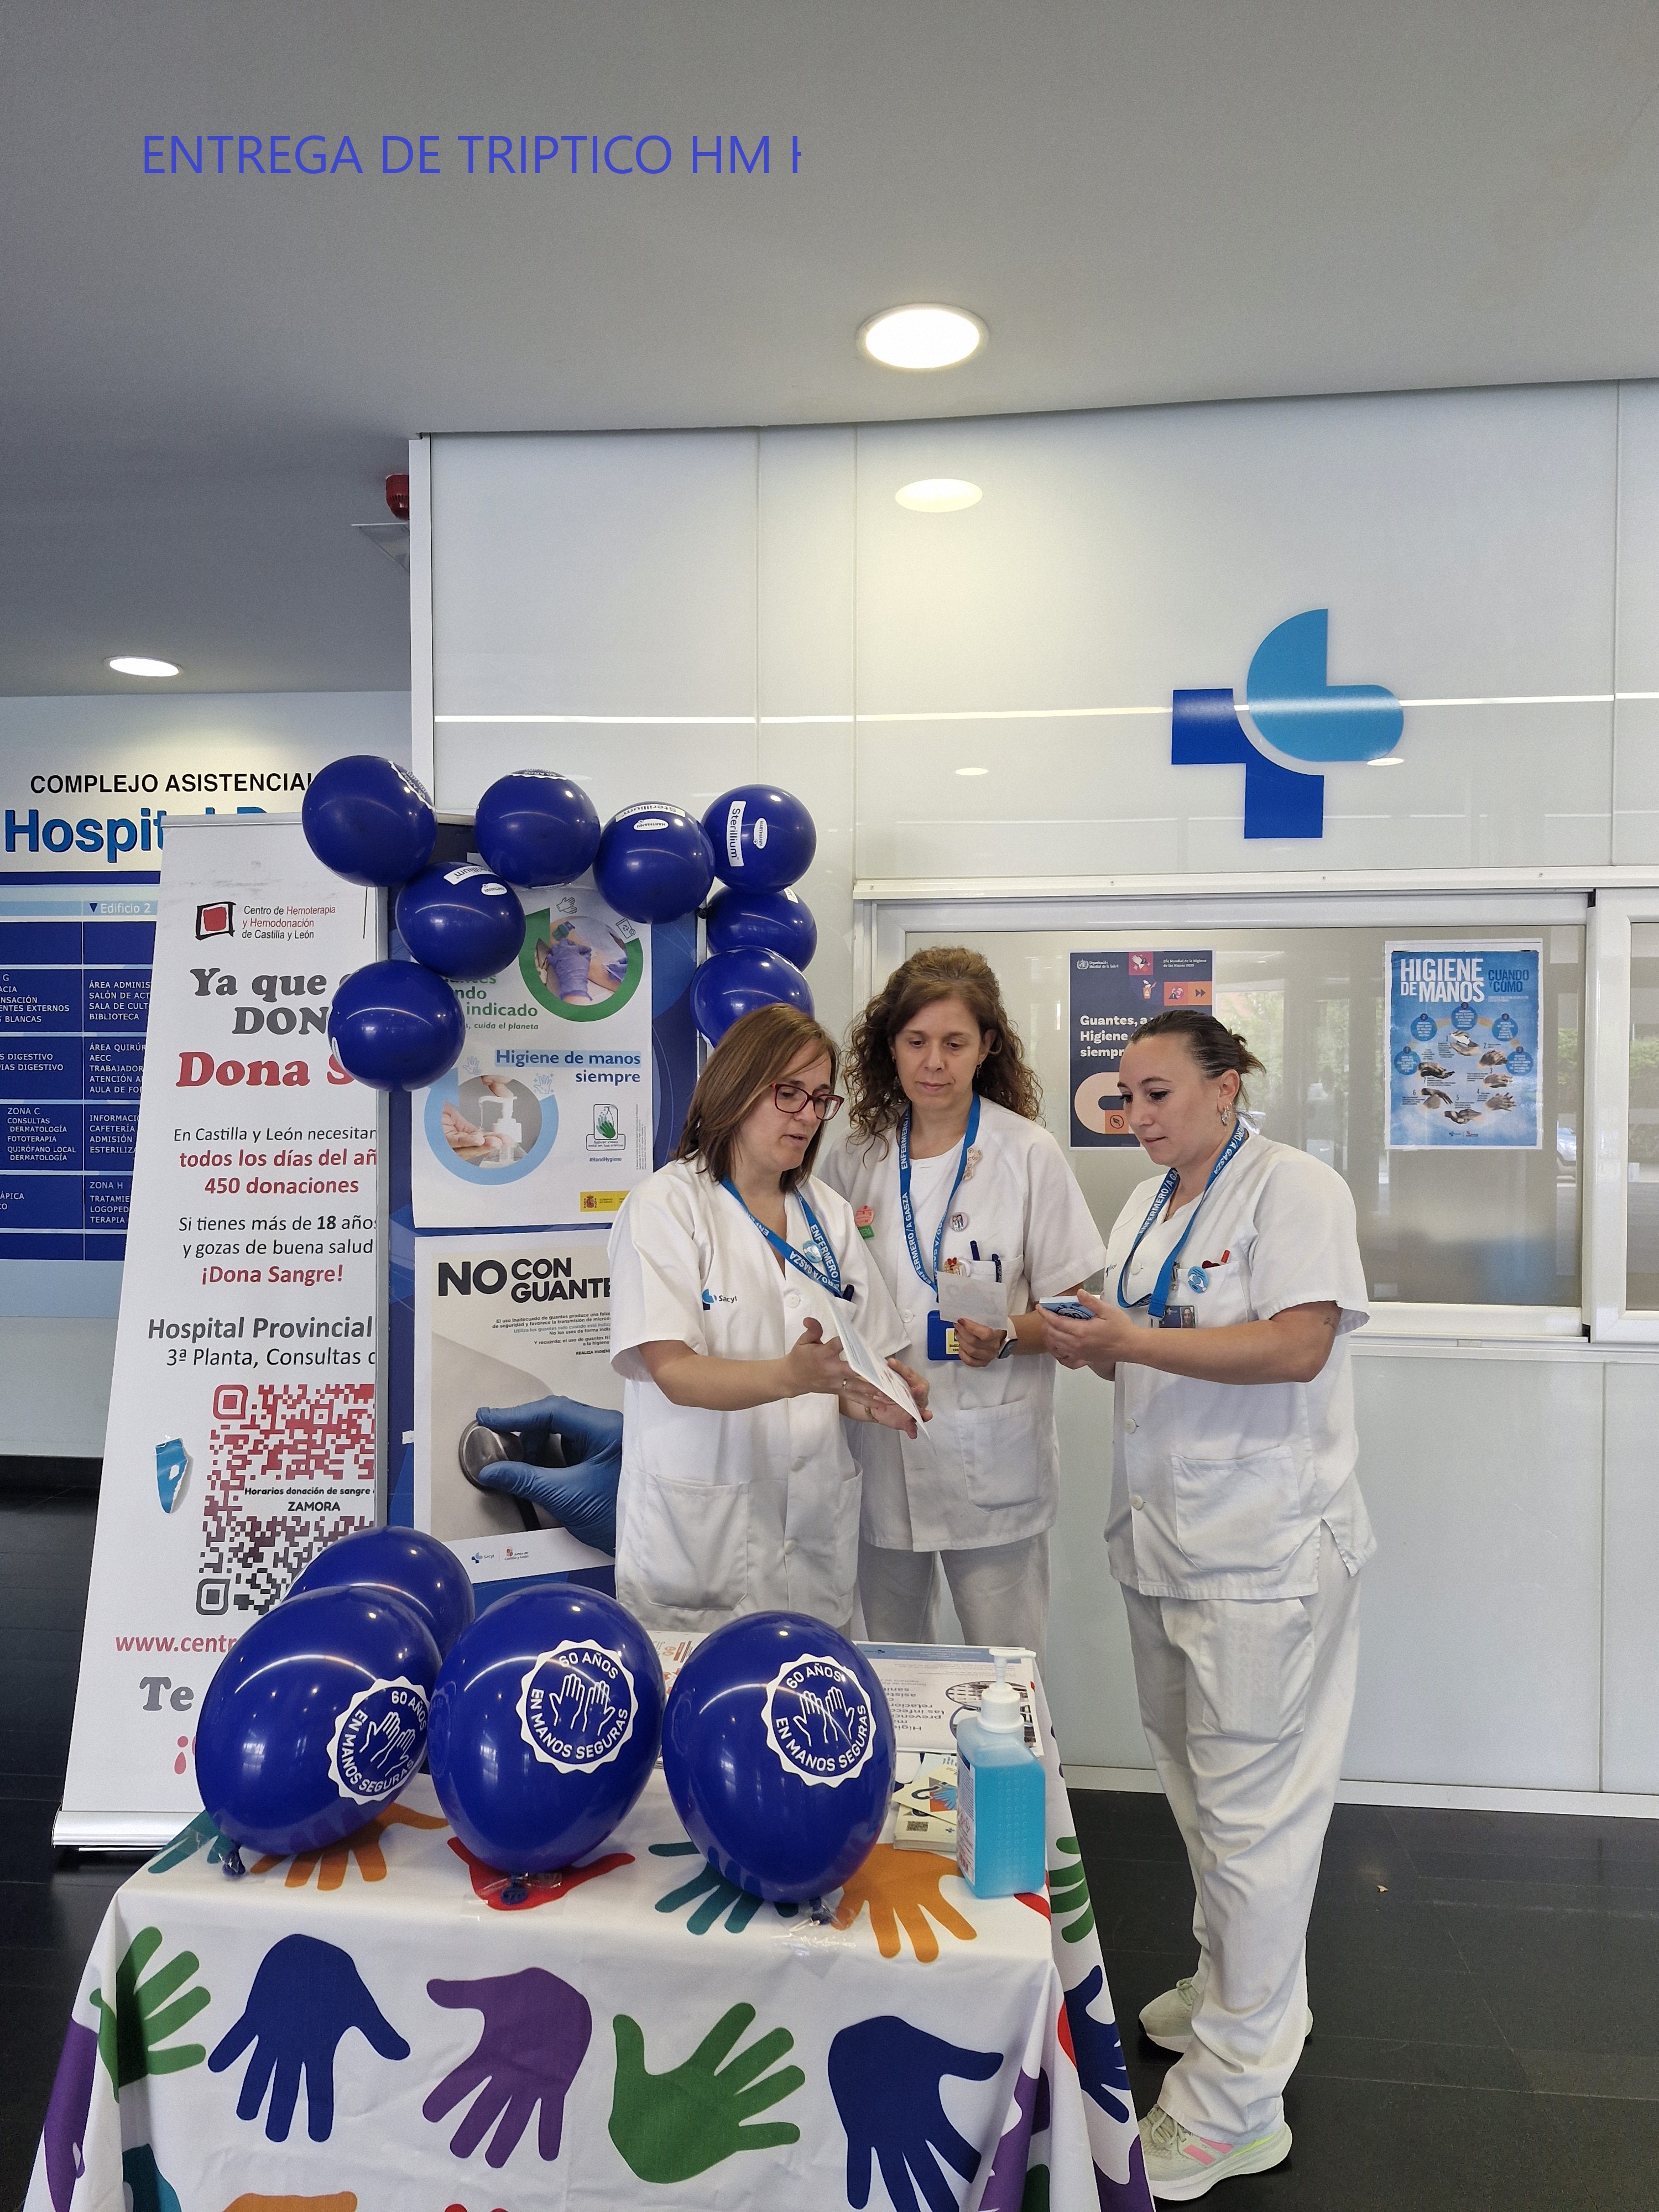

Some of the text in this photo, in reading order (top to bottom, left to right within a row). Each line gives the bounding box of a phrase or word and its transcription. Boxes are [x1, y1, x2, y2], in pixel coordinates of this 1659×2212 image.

[30, 774, 158, 794] COMPLEJO
[101, 902, 151, 914] Edificio 2
[244, 905, 336, 916] Centro de Hemoterapia
[242, 918, 314, 930] y Hemodonación
[242, 930, 314, 941] de Castilla y León
[1400, 958, 1484, 982] HIGIENE
[89, 980, 111, 988] ÁREA
[190, 968, 238, 996] Ya
[252, 973, 327, 1003] que
[1400, 980, 1485, 1003] DE MANOS
[89, 990, 116, 999] SALÓN
[466, 1001, 538, 1017] indicado
[232, 1006, 330, 1035] DON
[508, 1022, 539, 1031] planeta
[1080, 1015, 1138, 1027] Guantes,
[1080, 1031, 1128, 1044] Higiene
[90, 1042, 146, 1052] ÁREA QUIRÚR
[1080, 1046, 1125, 1060] siempr
[495, 1050, 641, 1068] Higiene de manos
[176, 1051, 311, 1087] Dona
[575, 1069, 641, 1086] siempre
[90, 1074, 132, 1083] ATENCIÓN
[10, 1124, 67, 1133] DERMATOLOGÍA
[90, 1123, 135, 1132] CAFETERÍA
[174, 1129, 190, 1141] En
[196, 1126, 247, 1141] Castilla
[253, 1131, 262, 1144] y
[267, 1126, 302, 1141] León
[90, 1134, 132, 1143] ADMISIÓN
[7, 1144, 50, 1153] QUIRÓFANO
[10, 1151, 67, 1161] DERMATOLOGÍA
[180, 1148, 377, 1167] todos los días del añ
[1213, 1148, 1233, 1175] GASZA
[205, 1176, 359, 1194] 450 donaciones
[901, 1192, 912, 1222] GASZA
[179, 1217, 192, 1232] Si
[197, 1217, 246, 1231] tienes
[252, 1216, 286, 1230] más
[292, 1215, 311, 1230] de
[317, 1215, 336, 1230] 18
[183, 1238, 373, 1259] y gozas de buena salud
[511, 1257, 572, 1281] CON
[789, 1251, 813, 1274] GASZA
[202, 1264, 343, 1286] ¡Dona Sangre!
[438, 1259, 508, 1297] NO
[511, 1277, 611, 1303] GUANTE
[148, 1316, 373, 1343] Hospital Provincial
[166, 1348, 187, 1366] 3ª
[193, 1348, 259, 1369] Planta,
[267, 1347, 361, 1366] Consultas
[244, 1487, 284, 1495] Horarios
[286, 1486, 325, 1495] donación
[340, 1488, 371, 1496] sangre
[288, 1501, 341, 1512] ZAMORA
[559, 1652, 619, 1679] 60 AÑOS
[786, 1663, 842, 1689] 60 AÑOS
[139, 1676, 194, 1712] Te
[391, 1690, 427, 1731] 60 AÑOS
[530, 1688, 628, 1760] EN MANOS SEGURAS
[776, 1704, 869, 1772] EN MANOS SEGURAS
[341, 1709, 415, 1793] EN MANOS SEGURAS
